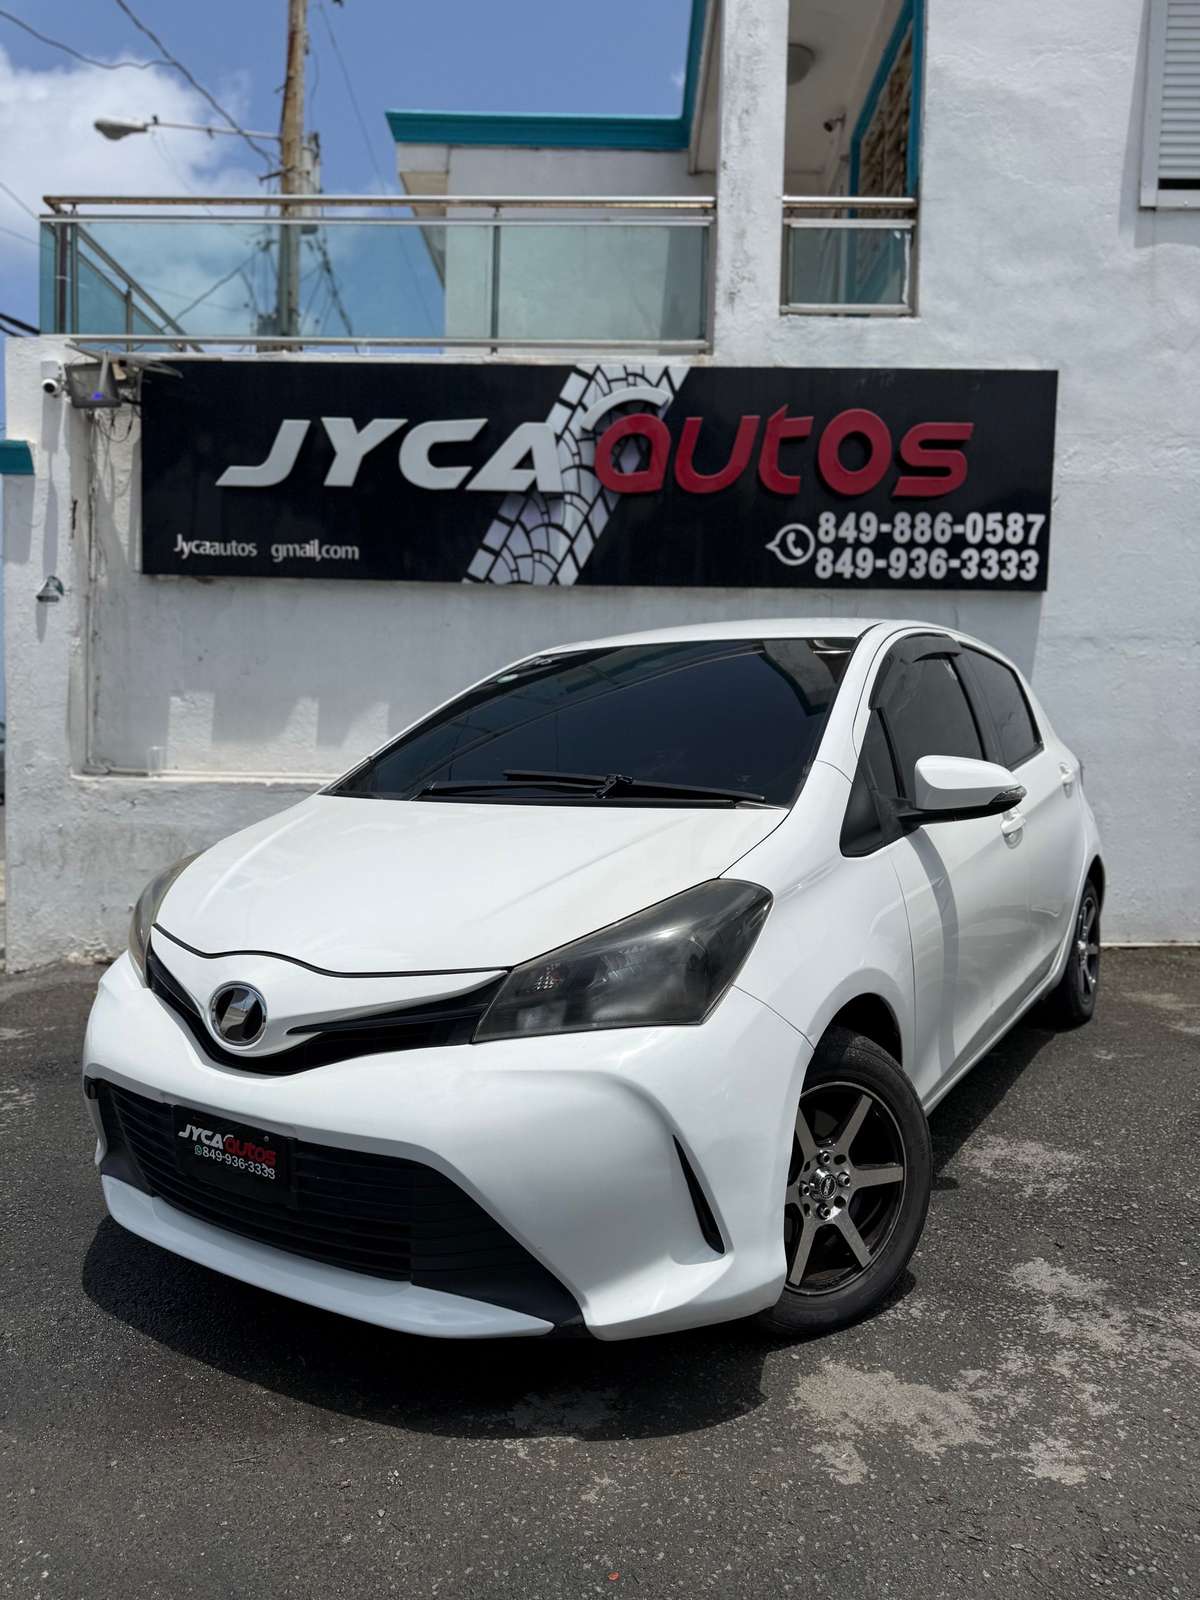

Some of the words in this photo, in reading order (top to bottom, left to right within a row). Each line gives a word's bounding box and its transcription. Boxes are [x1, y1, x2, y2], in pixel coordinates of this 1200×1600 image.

[215, 416, 565, 493] JYCA
[817, 511, 1046, 546] 849-886-0587
[173, 533, 259, 559] Jycaautos
[814, 547, 1040, 581] 849-936-3333
[178, 1123, 224, 1149] JYCA
